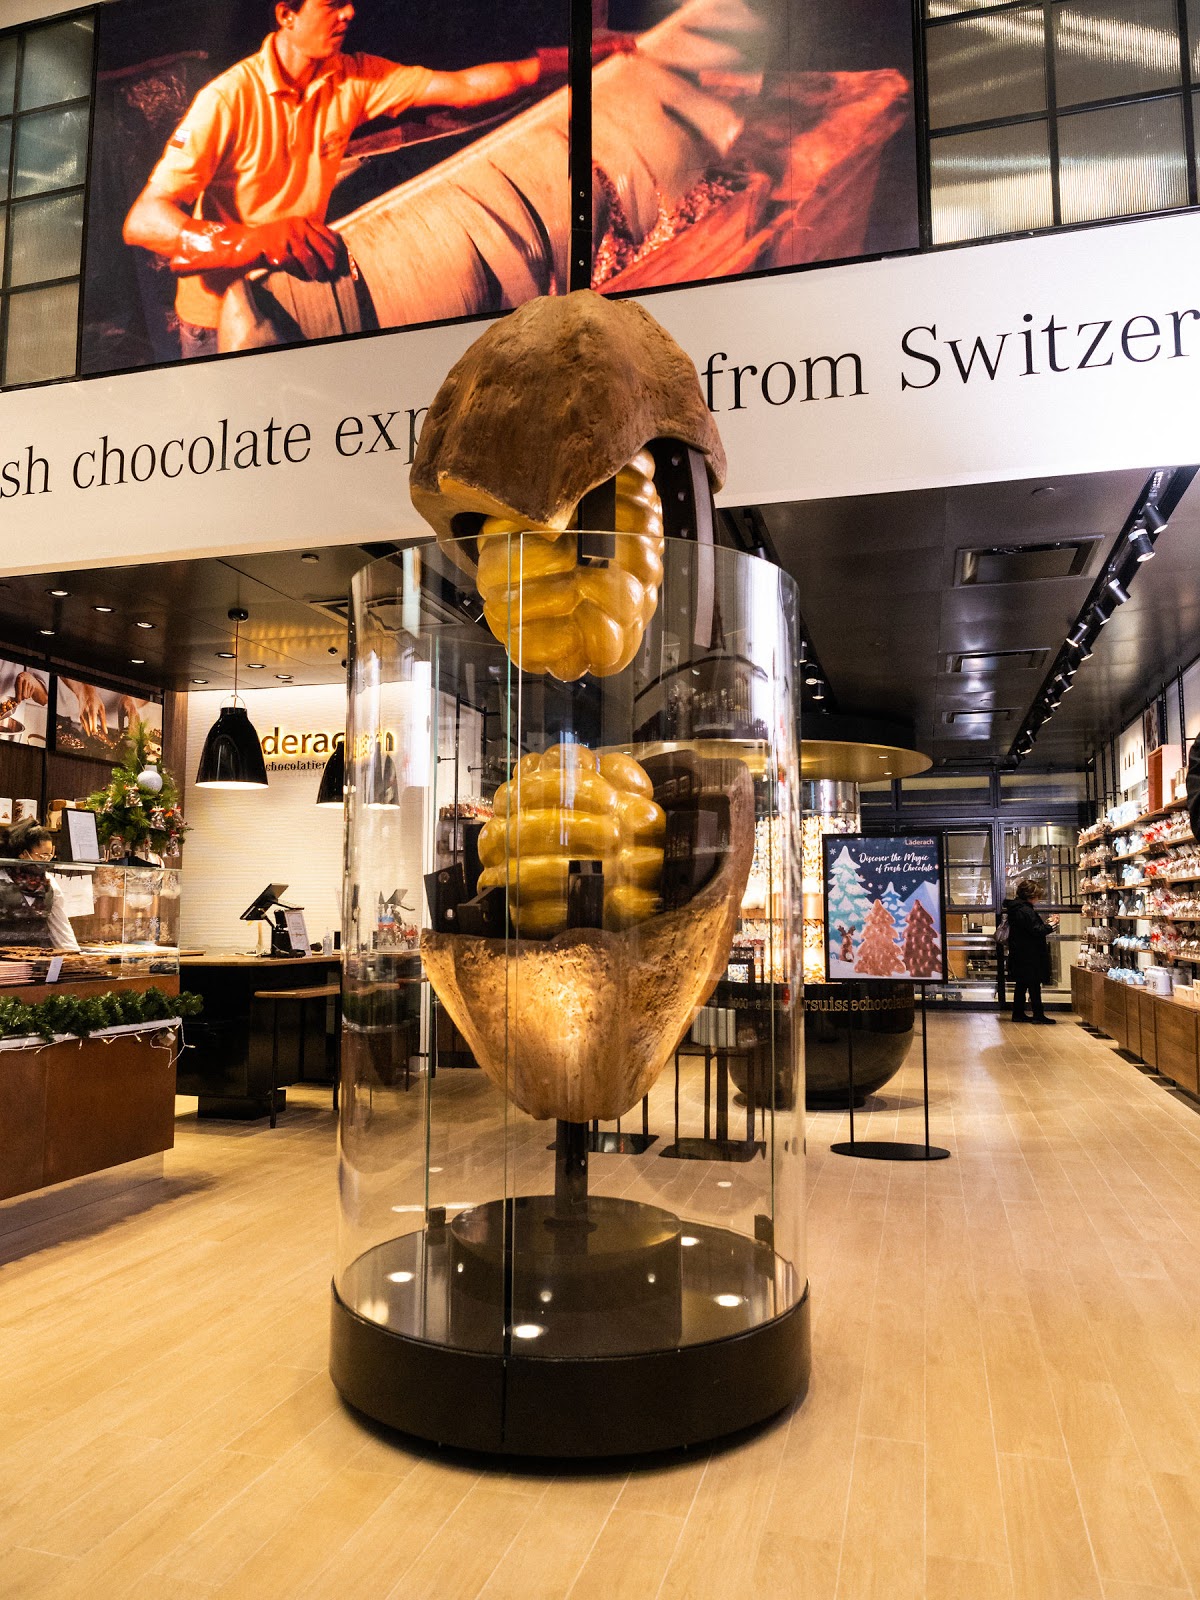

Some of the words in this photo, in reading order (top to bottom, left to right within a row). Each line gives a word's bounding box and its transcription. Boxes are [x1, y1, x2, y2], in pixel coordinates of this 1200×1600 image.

[72, 416, 311, 489] chocolate
[700, 351, 870, 413] from
[901, 309, 1200, 392] Switzer
[859, 852, 889, 863] Discover
[890, 853, 902, 862] the
[904, 852, 928, 864] Magic
[875, 864, 883, 874] of
[883, 863, 902, 872] Fresh
[902, 863, 934, 873] Chocolate
